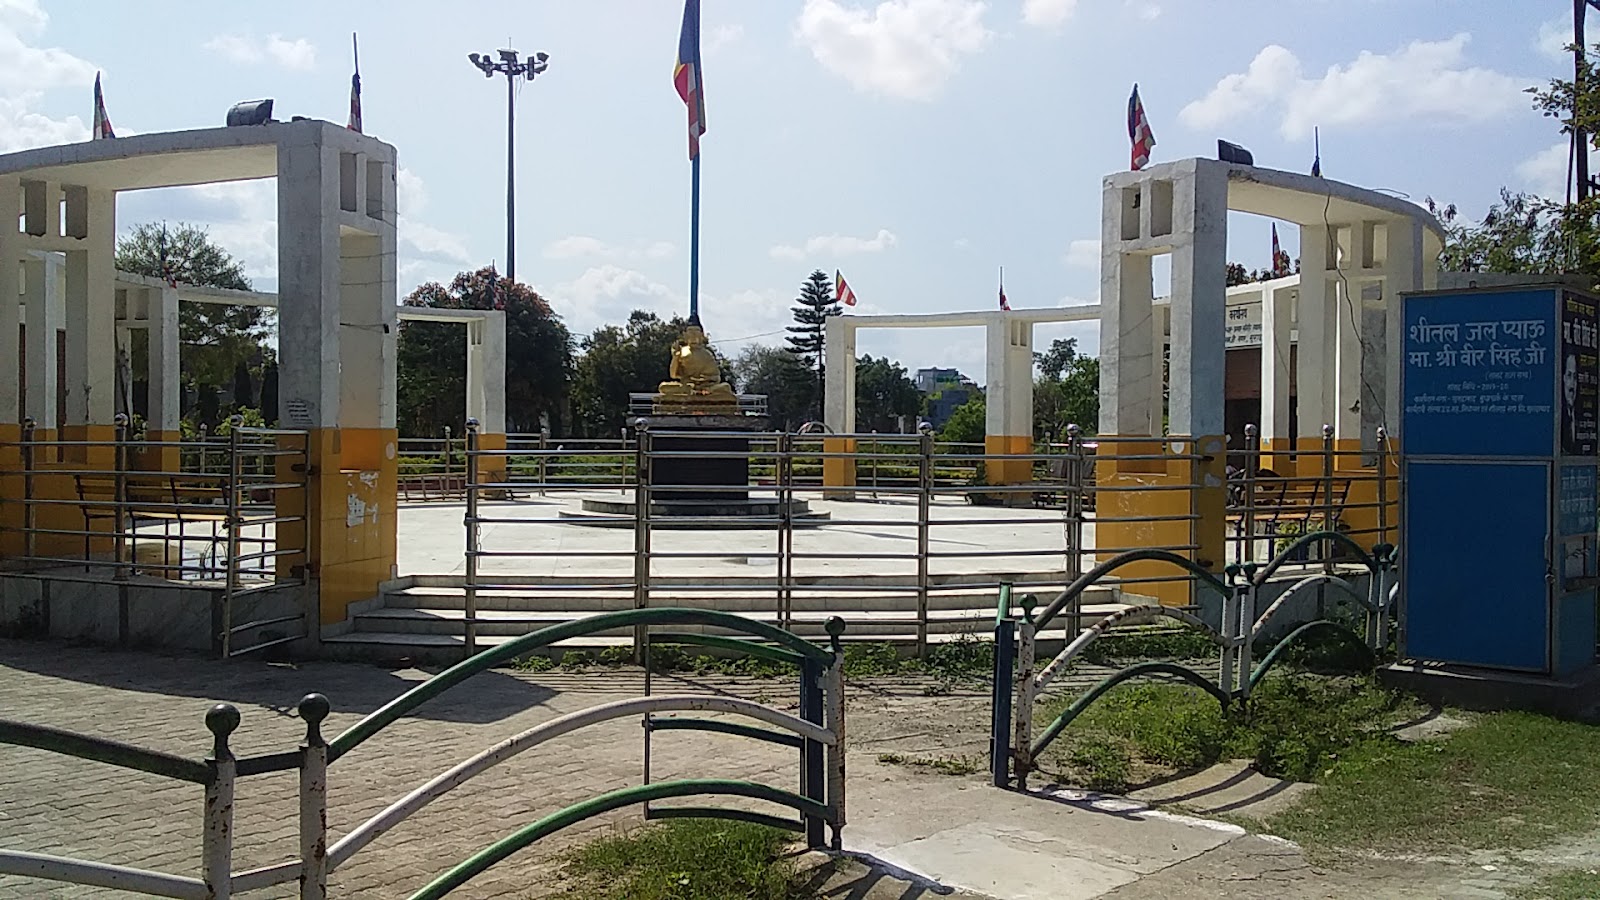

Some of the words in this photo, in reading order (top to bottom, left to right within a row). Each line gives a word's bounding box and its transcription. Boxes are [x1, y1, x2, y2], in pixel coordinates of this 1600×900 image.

[1409, 316, 1460, 343] शीतल
[1465, 321, 1499, 341] जल
[1501, 319, 1545, 339] प्याऊ
[1408, 351, 1433, 367] मा.
[1436, 343, 1457, 367] श्री
[1460, 343, 1486, 367] वीर
[1488, 341, 1522, 367] सिंह
[1524, 340, 1547, 365] जी
